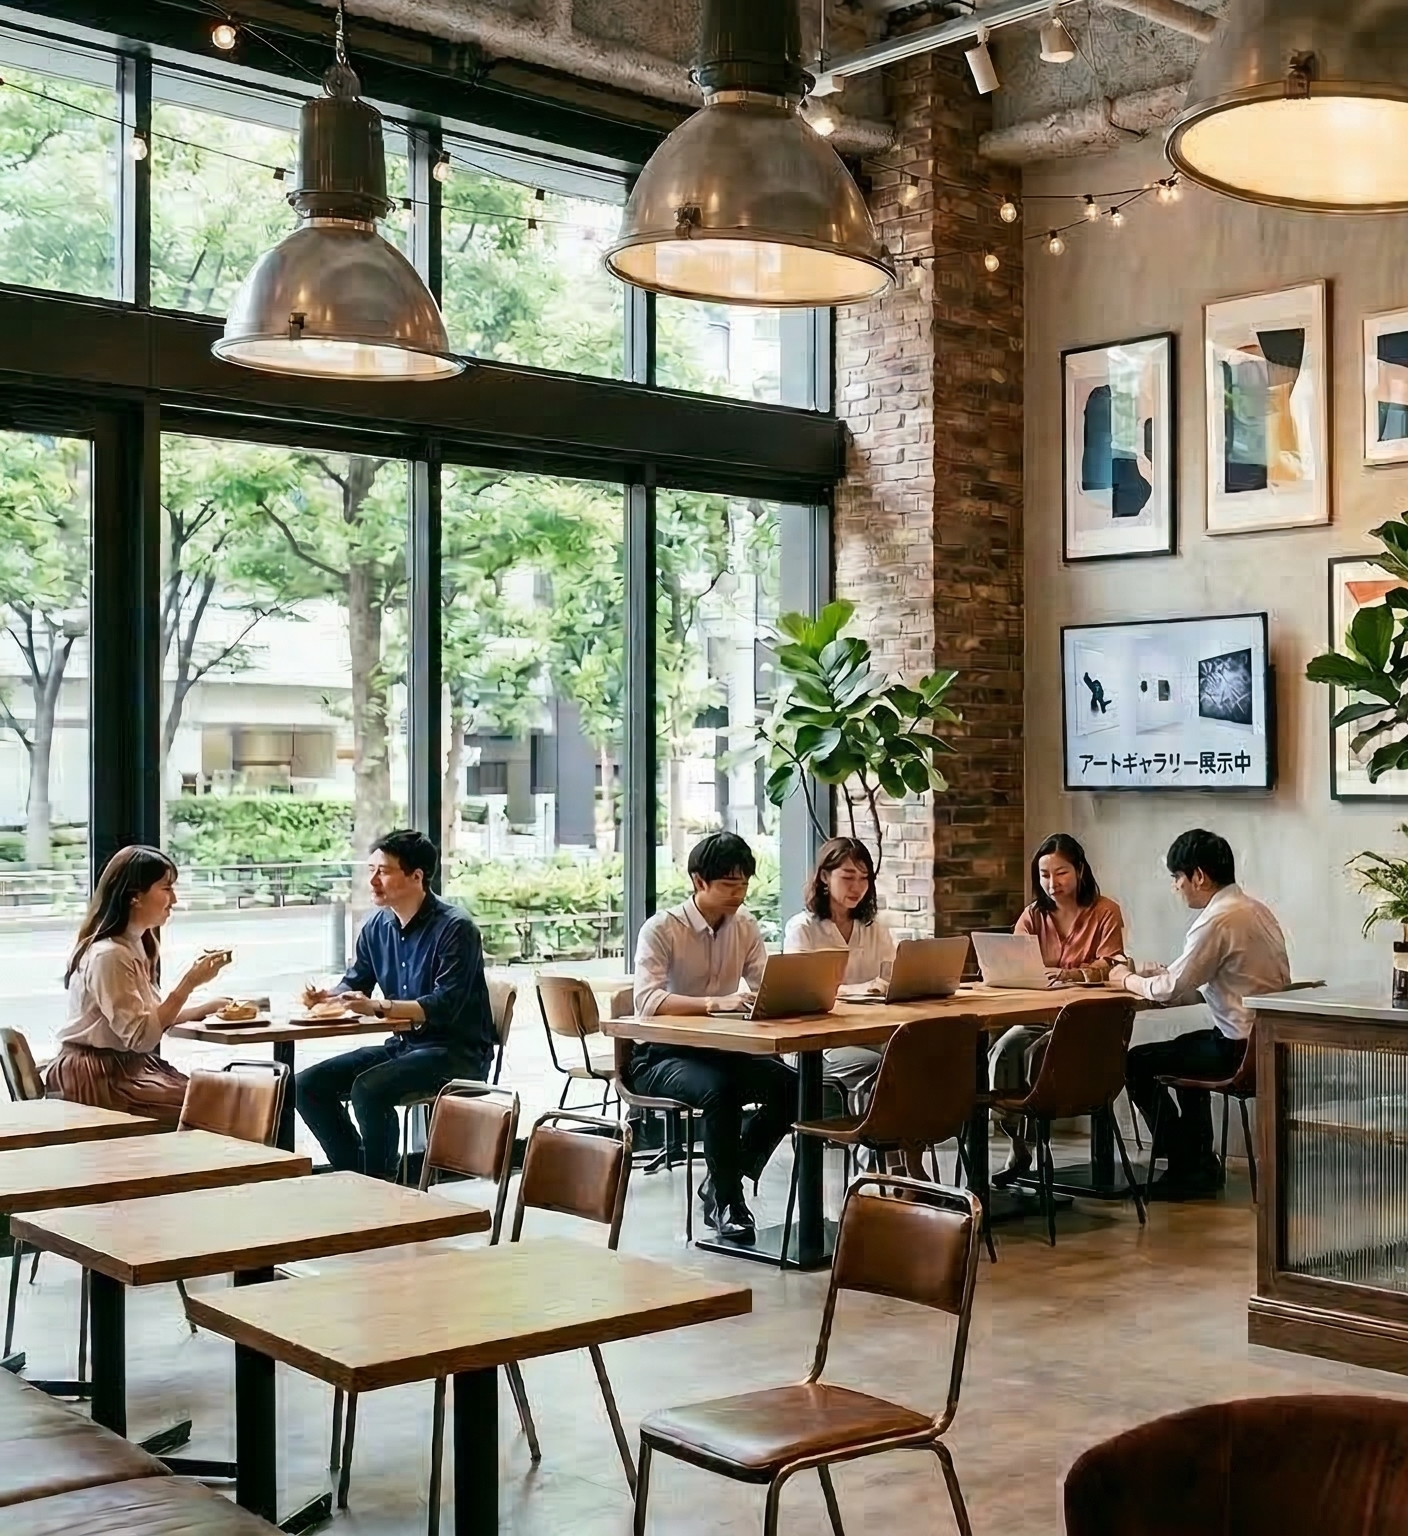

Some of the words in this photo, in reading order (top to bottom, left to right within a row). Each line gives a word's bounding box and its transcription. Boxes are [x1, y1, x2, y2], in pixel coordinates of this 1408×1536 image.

[1079, 750, 1251, 775] アートギャラリー展示中
